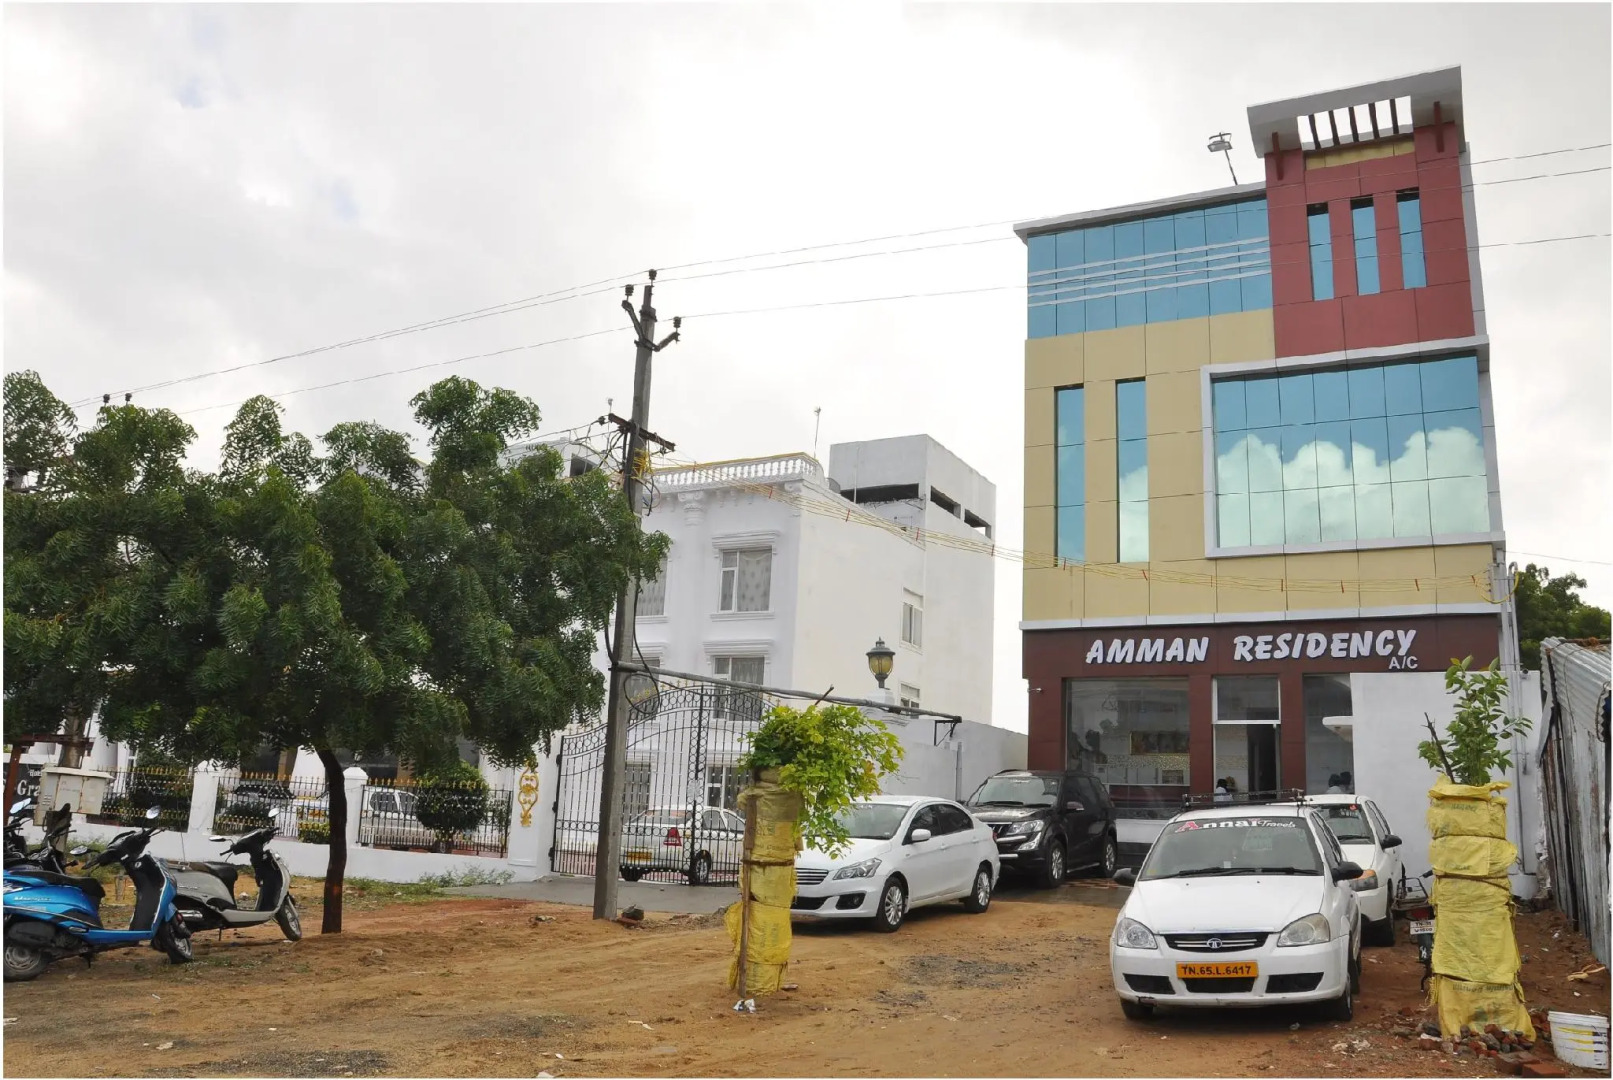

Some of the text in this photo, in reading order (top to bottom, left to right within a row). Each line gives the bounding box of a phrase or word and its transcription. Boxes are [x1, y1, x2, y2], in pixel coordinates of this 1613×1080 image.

[1085, 629, 1417, 664] AMMAN RESIDENCY
[1388, 655, 1418, 670] A/C
[17, 779, 41, 797] Gra
[1174, 818, 1296, 833] Annai Travels
[1181, 965, 1252, 976] TN.65.L.6417
